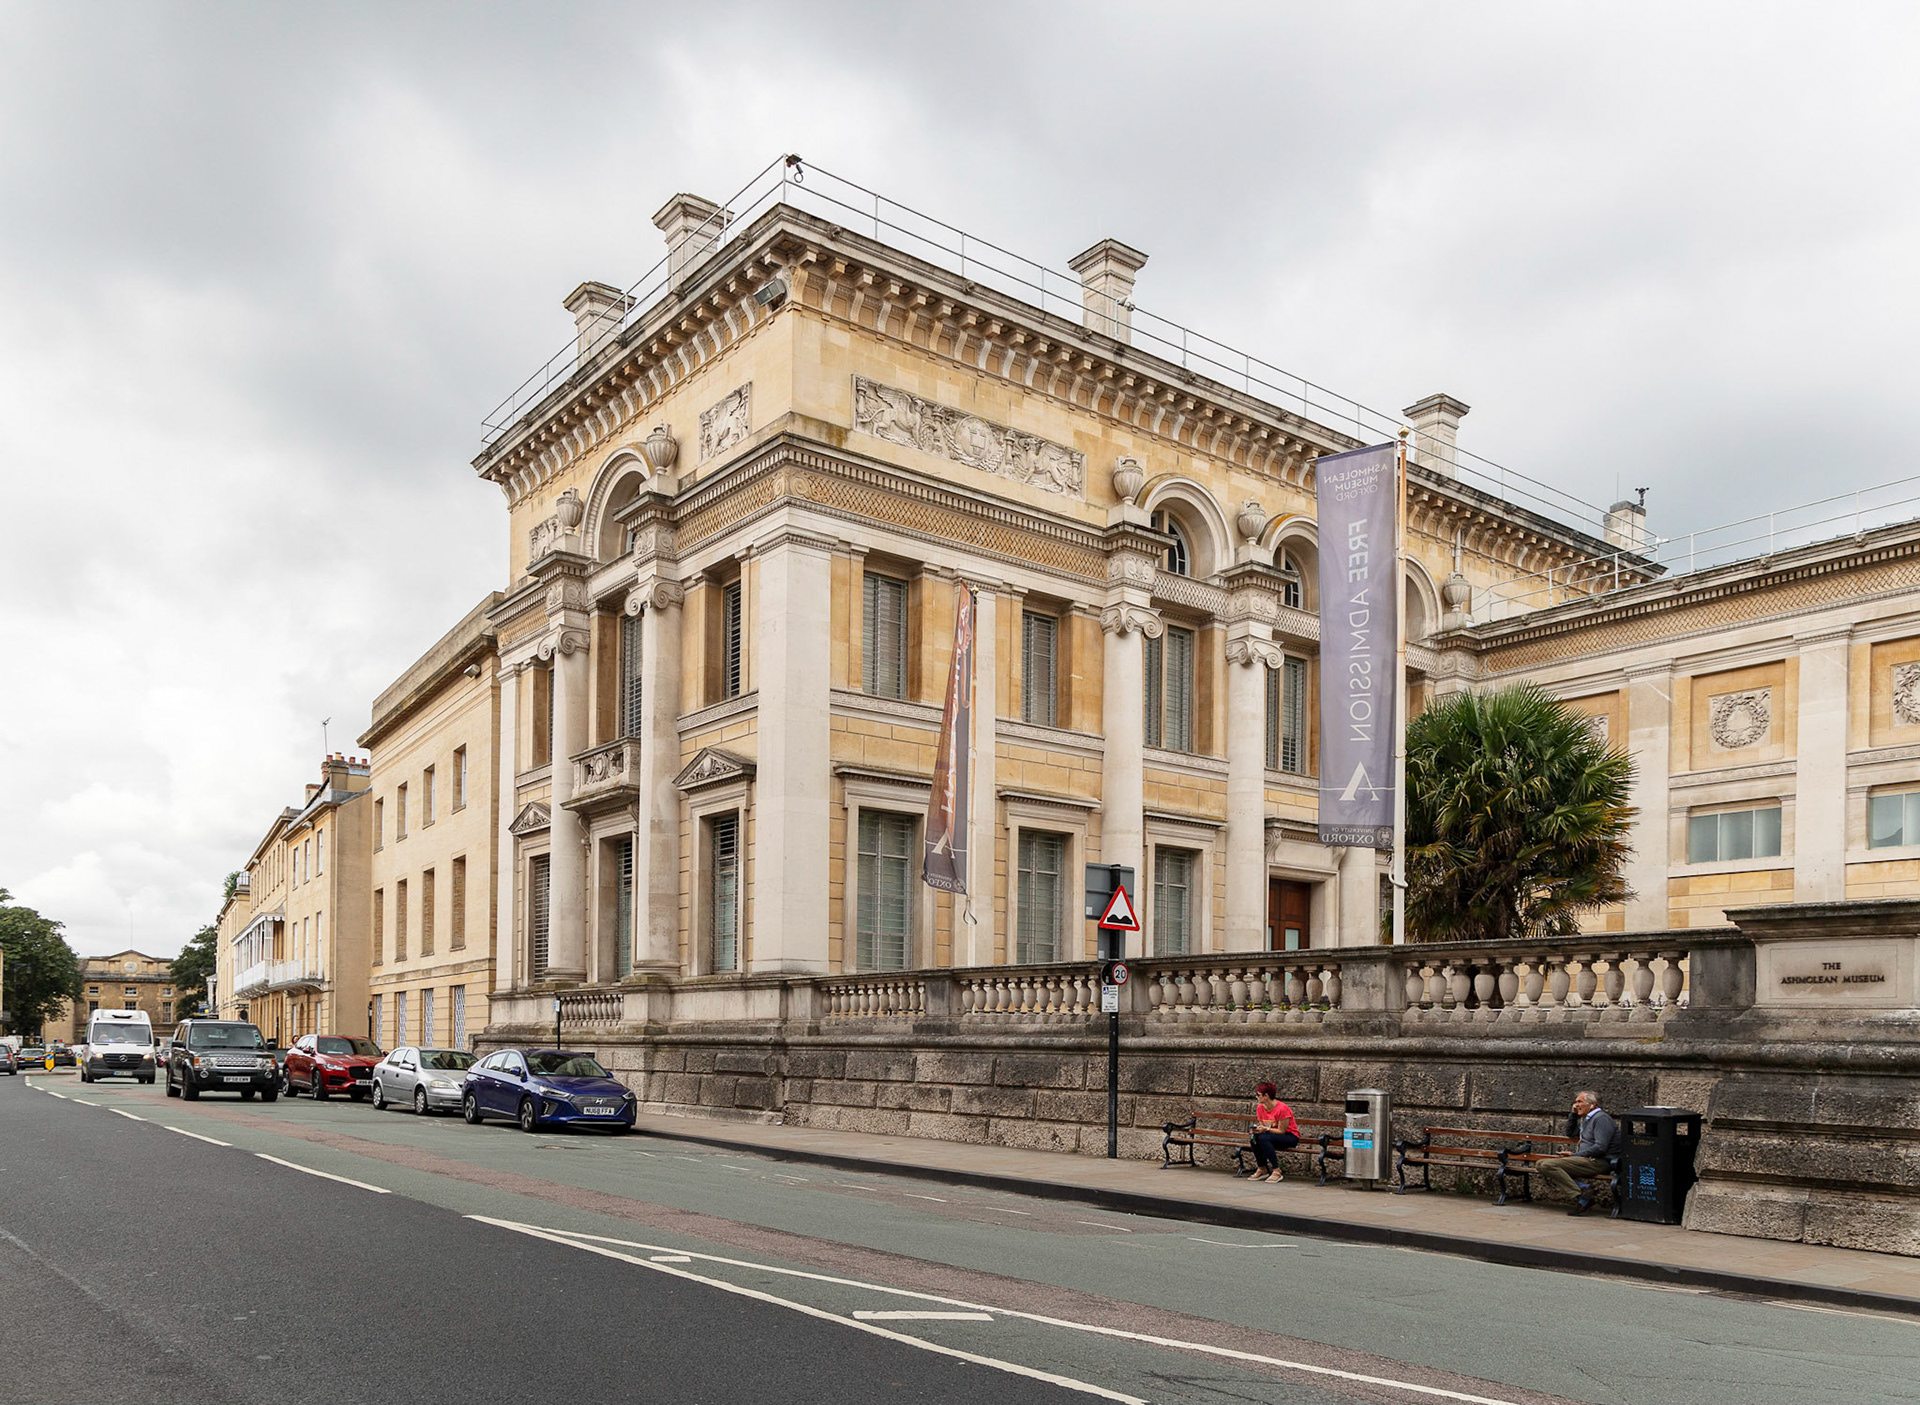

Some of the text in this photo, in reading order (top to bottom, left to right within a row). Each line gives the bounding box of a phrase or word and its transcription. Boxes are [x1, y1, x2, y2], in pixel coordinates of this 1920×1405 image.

[1822, 962, 1841, 970] THE
[1115, 969, 1127, 979] 20
[1780, 975, 1885, 985] ASHMOLEAN MUSEUM
